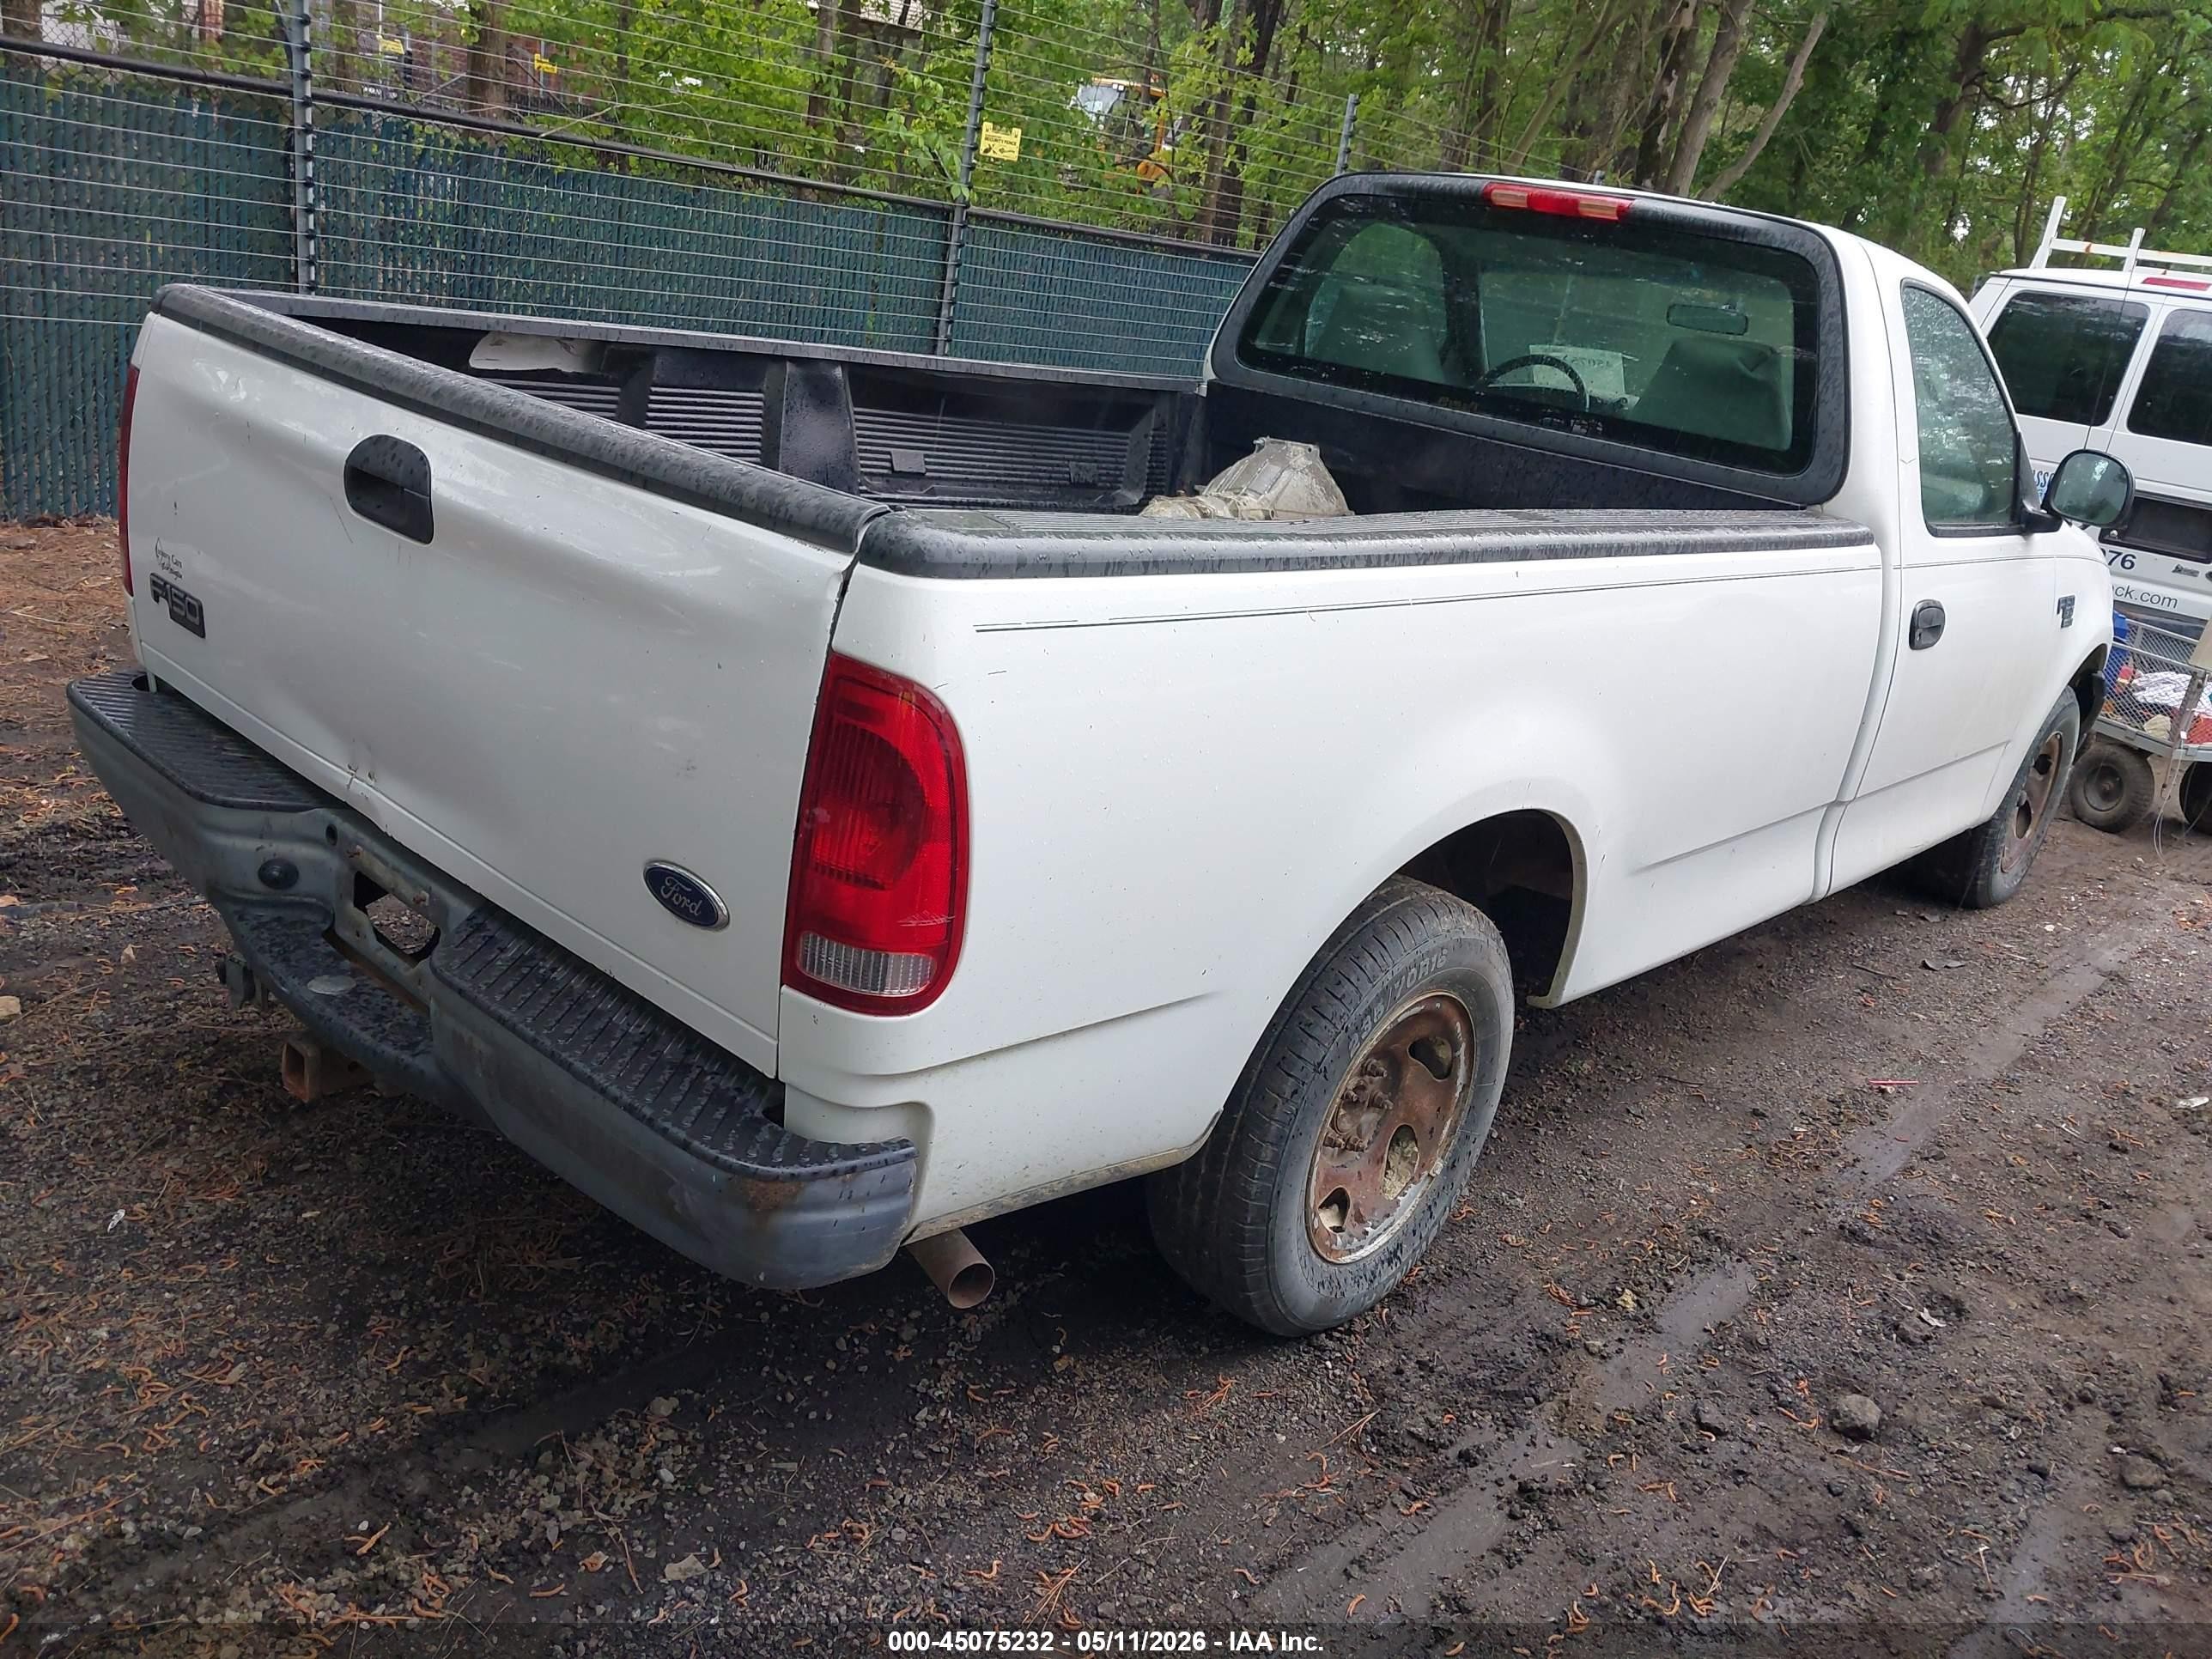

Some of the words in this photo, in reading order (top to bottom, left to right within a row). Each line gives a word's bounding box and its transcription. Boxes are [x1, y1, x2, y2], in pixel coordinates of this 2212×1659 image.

[2100, 548, 2136, 570] 76
[2112, 585, 2178, 609] ck.com
[660, 876, 702, 916] Ford
